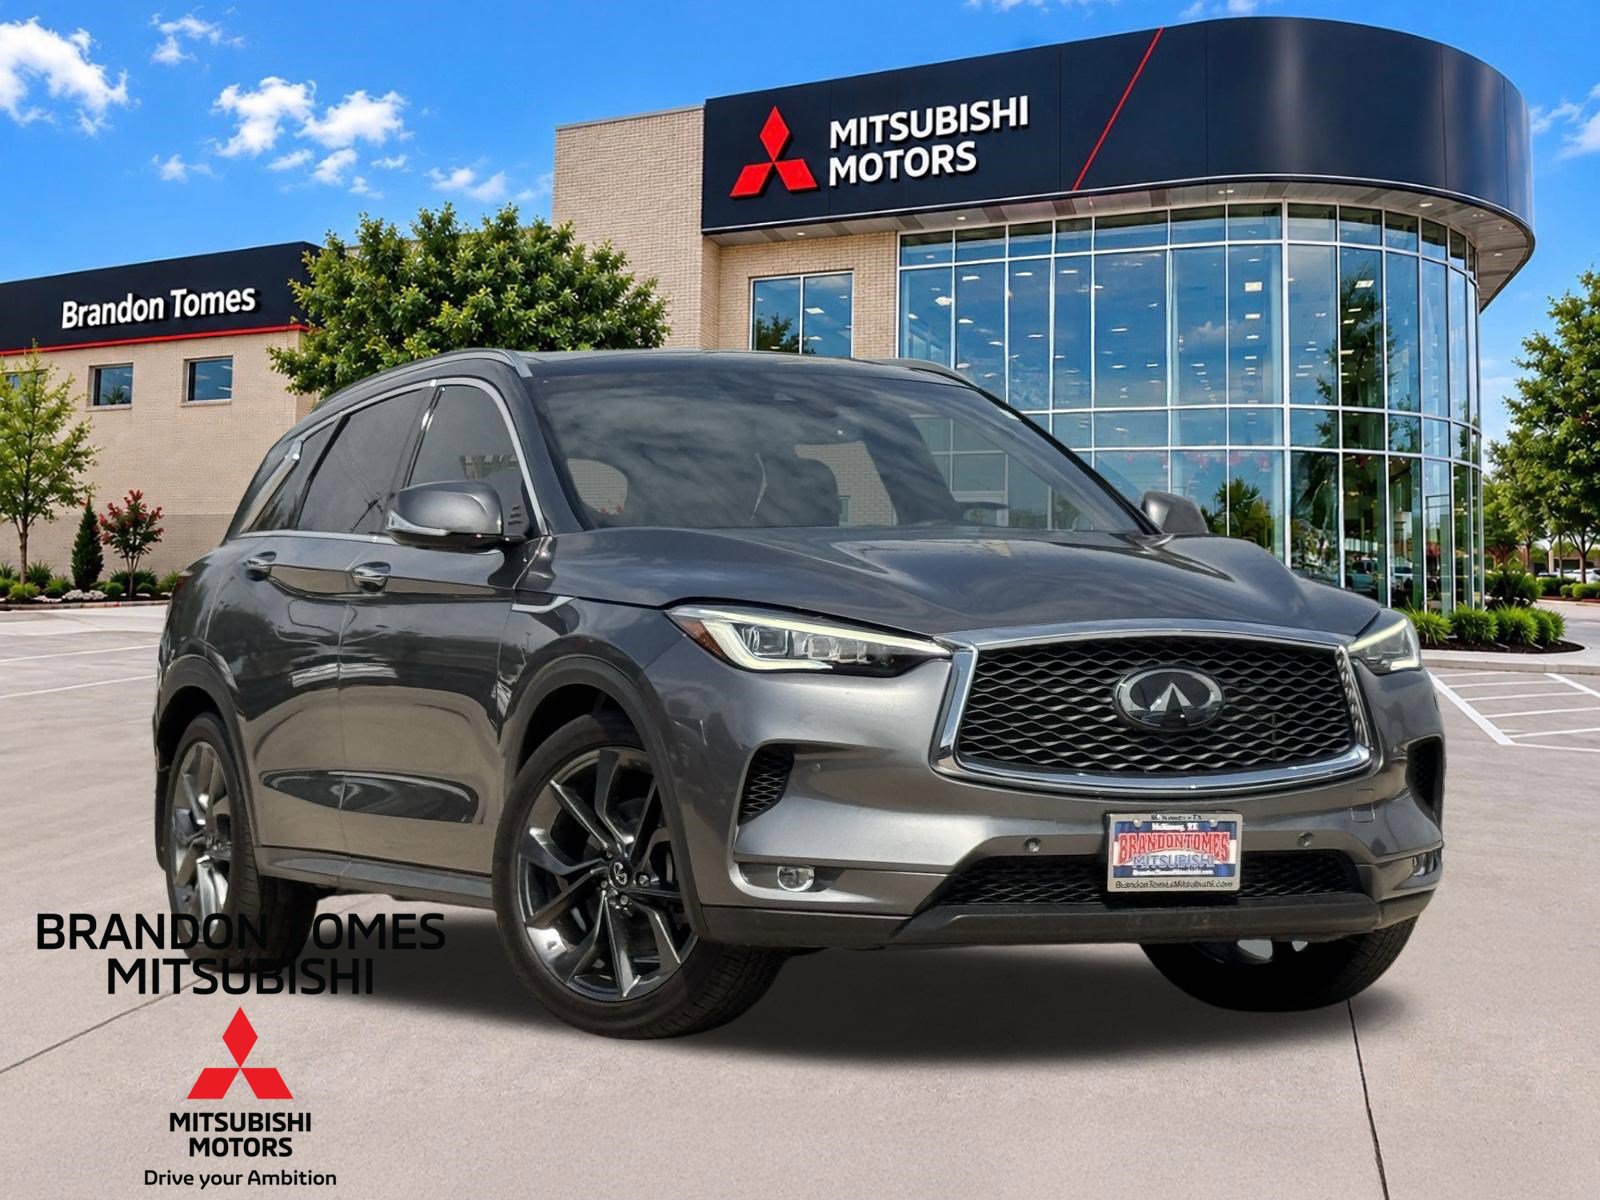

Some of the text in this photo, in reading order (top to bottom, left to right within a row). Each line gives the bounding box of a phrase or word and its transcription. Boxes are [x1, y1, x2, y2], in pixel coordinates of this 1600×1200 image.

[830, 96, 1028, 148] MITSUBISHI
[829, 141, 977, 186] MOTORS
[61, 288, 255, 328] Brandon Tomes
